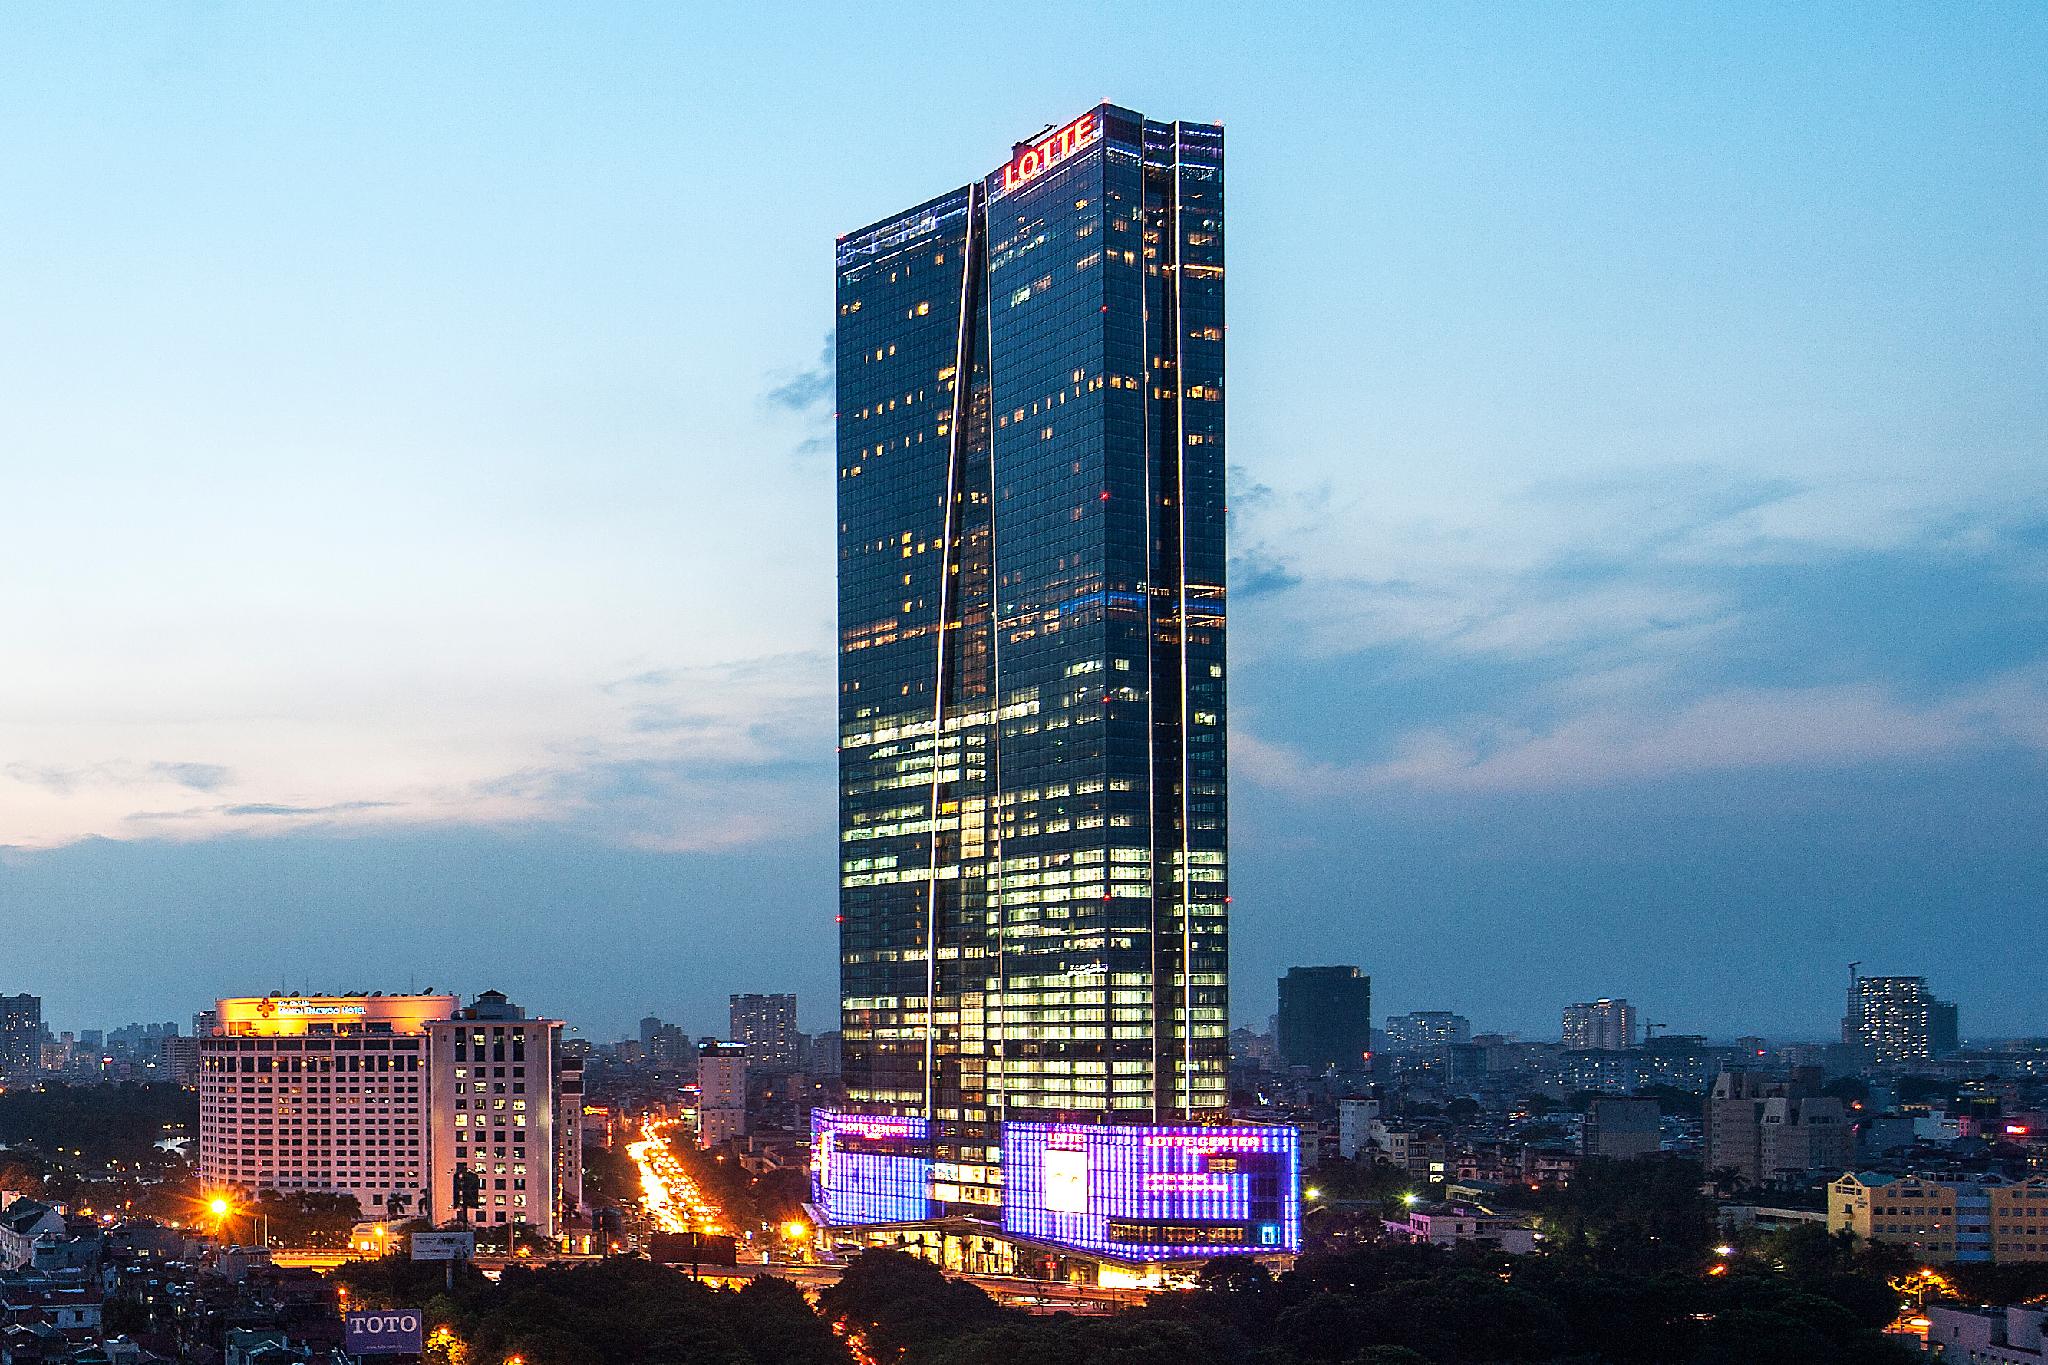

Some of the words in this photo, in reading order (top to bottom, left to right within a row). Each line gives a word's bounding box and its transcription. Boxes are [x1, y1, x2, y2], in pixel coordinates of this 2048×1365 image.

[1003, 113, 1095, 192] LOTTE
[1047, 1133, 1084, 1142] LOTTE
[1143, 1136, 1197, 1146] LOTTE
[1198, 1136, 1260, 1146] CENTER
[350, 1315, 417, 1334] TOTO
